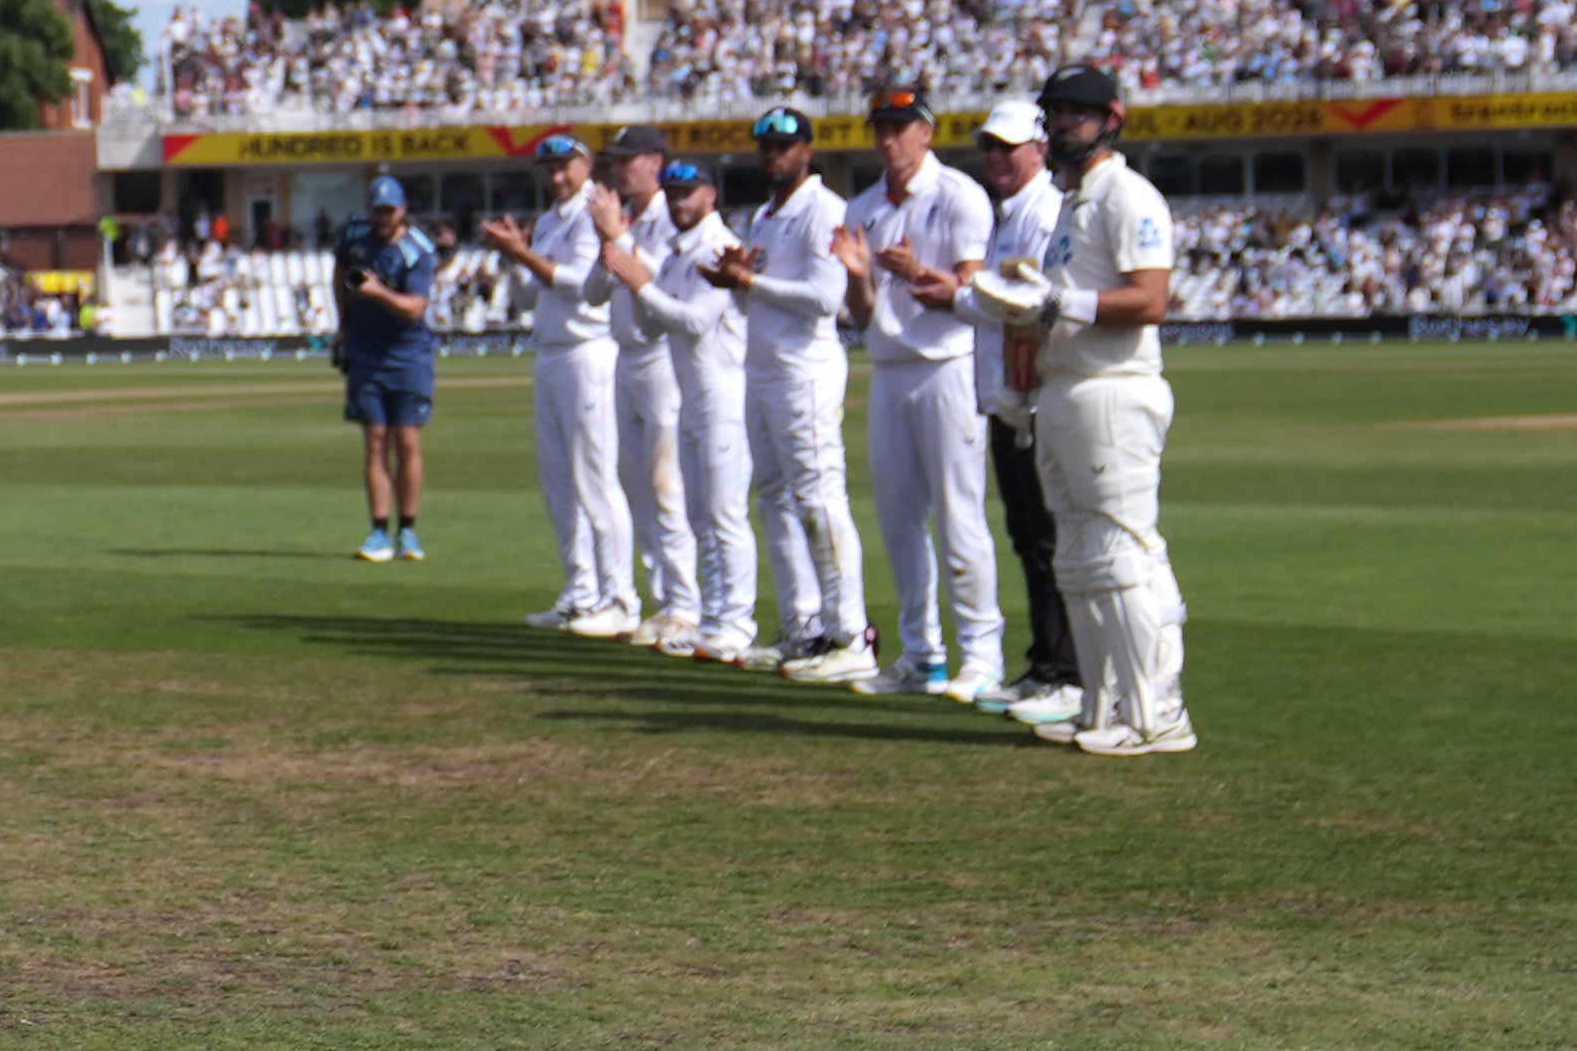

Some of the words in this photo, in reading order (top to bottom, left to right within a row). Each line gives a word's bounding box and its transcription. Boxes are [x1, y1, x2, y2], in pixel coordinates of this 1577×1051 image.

[238, 133, 361, 158] HUNDRED
[371, 132, 393, 155] IS
[401, 130, 468, 153] BACK
